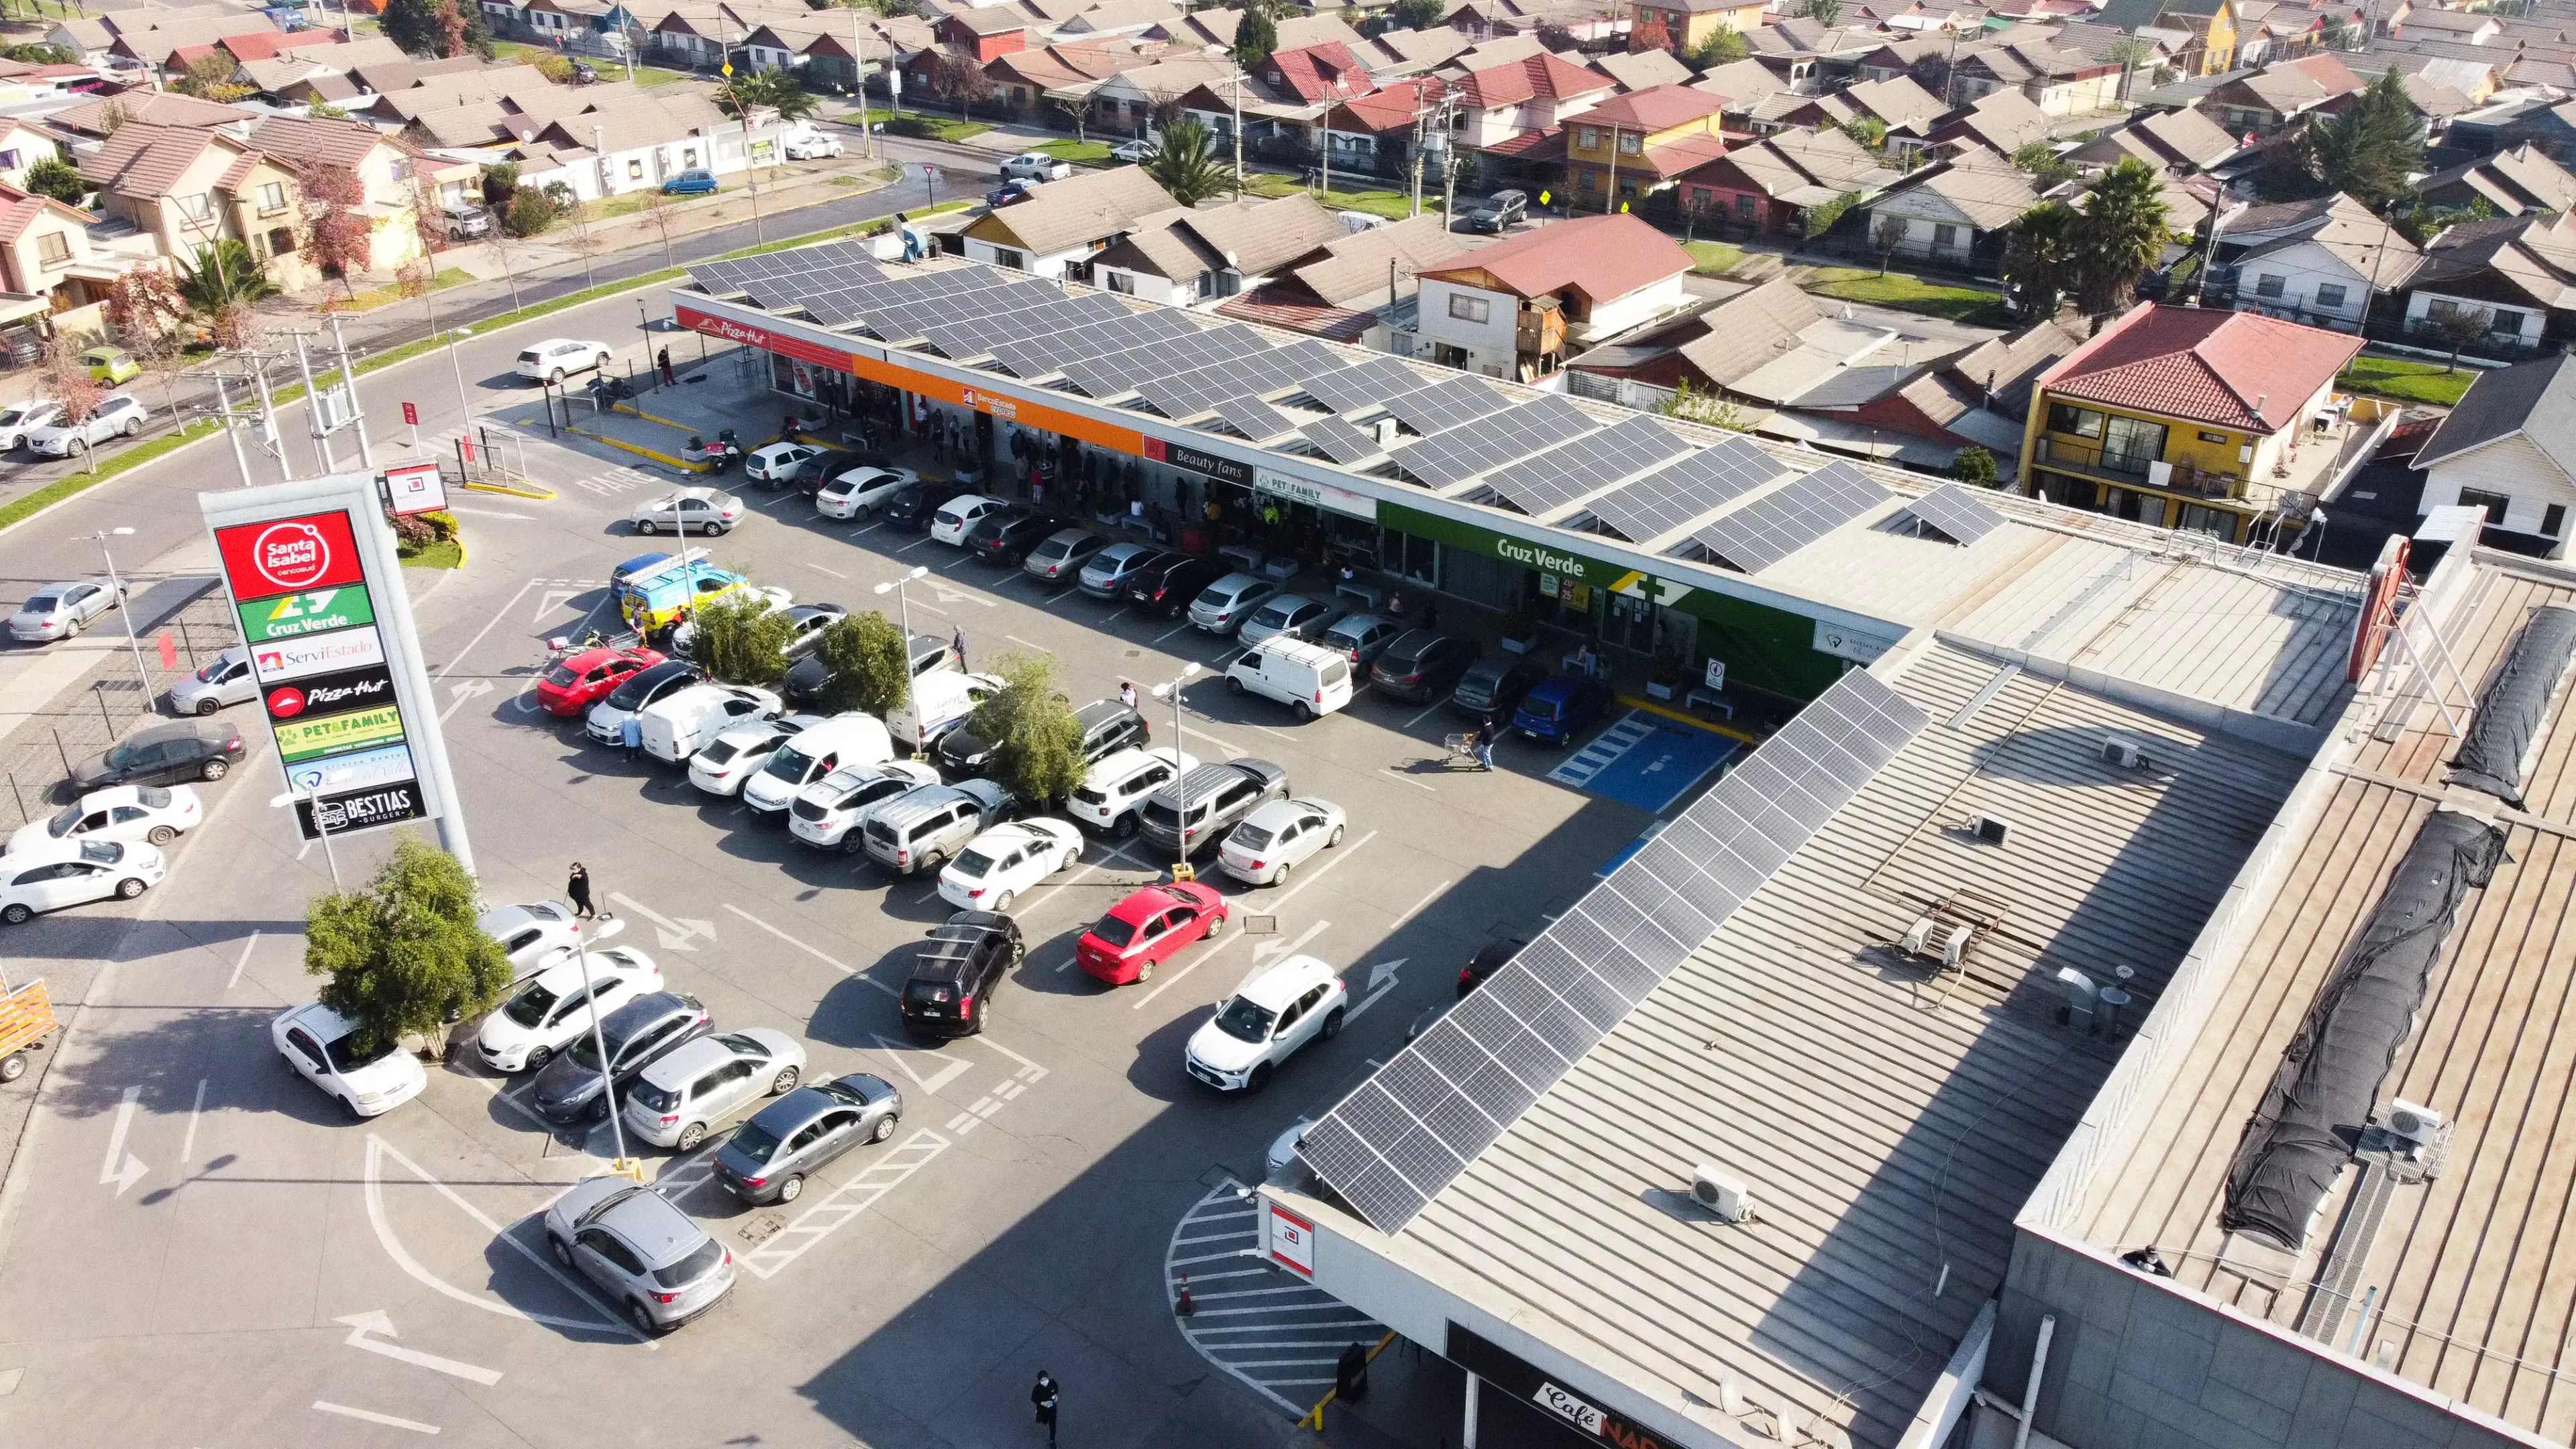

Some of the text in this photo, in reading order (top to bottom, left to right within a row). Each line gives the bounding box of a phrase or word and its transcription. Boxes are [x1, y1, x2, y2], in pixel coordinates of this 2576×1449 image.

[721, 322, 766, 345] Pizza Hut
[1177, 449, 1242, 478] Beauty fans
[267, 539, 315, 555] Santa
[268, 548, 315, 568] Isabel
[1497, 539, 1585, 578] Cruz Verde
[277, 564, 315, 576] cencosud
[266, 614, 347, 637] Cruz Verde
[286, 641, 372, 665] ServiEstado
[307, 679, 389, 706] Pizza Hut
[371, 751, 407, 762] Dental
[345, 790, 411, 819] BESTIAS
[1546, 1387, 1595, 1427] Café
